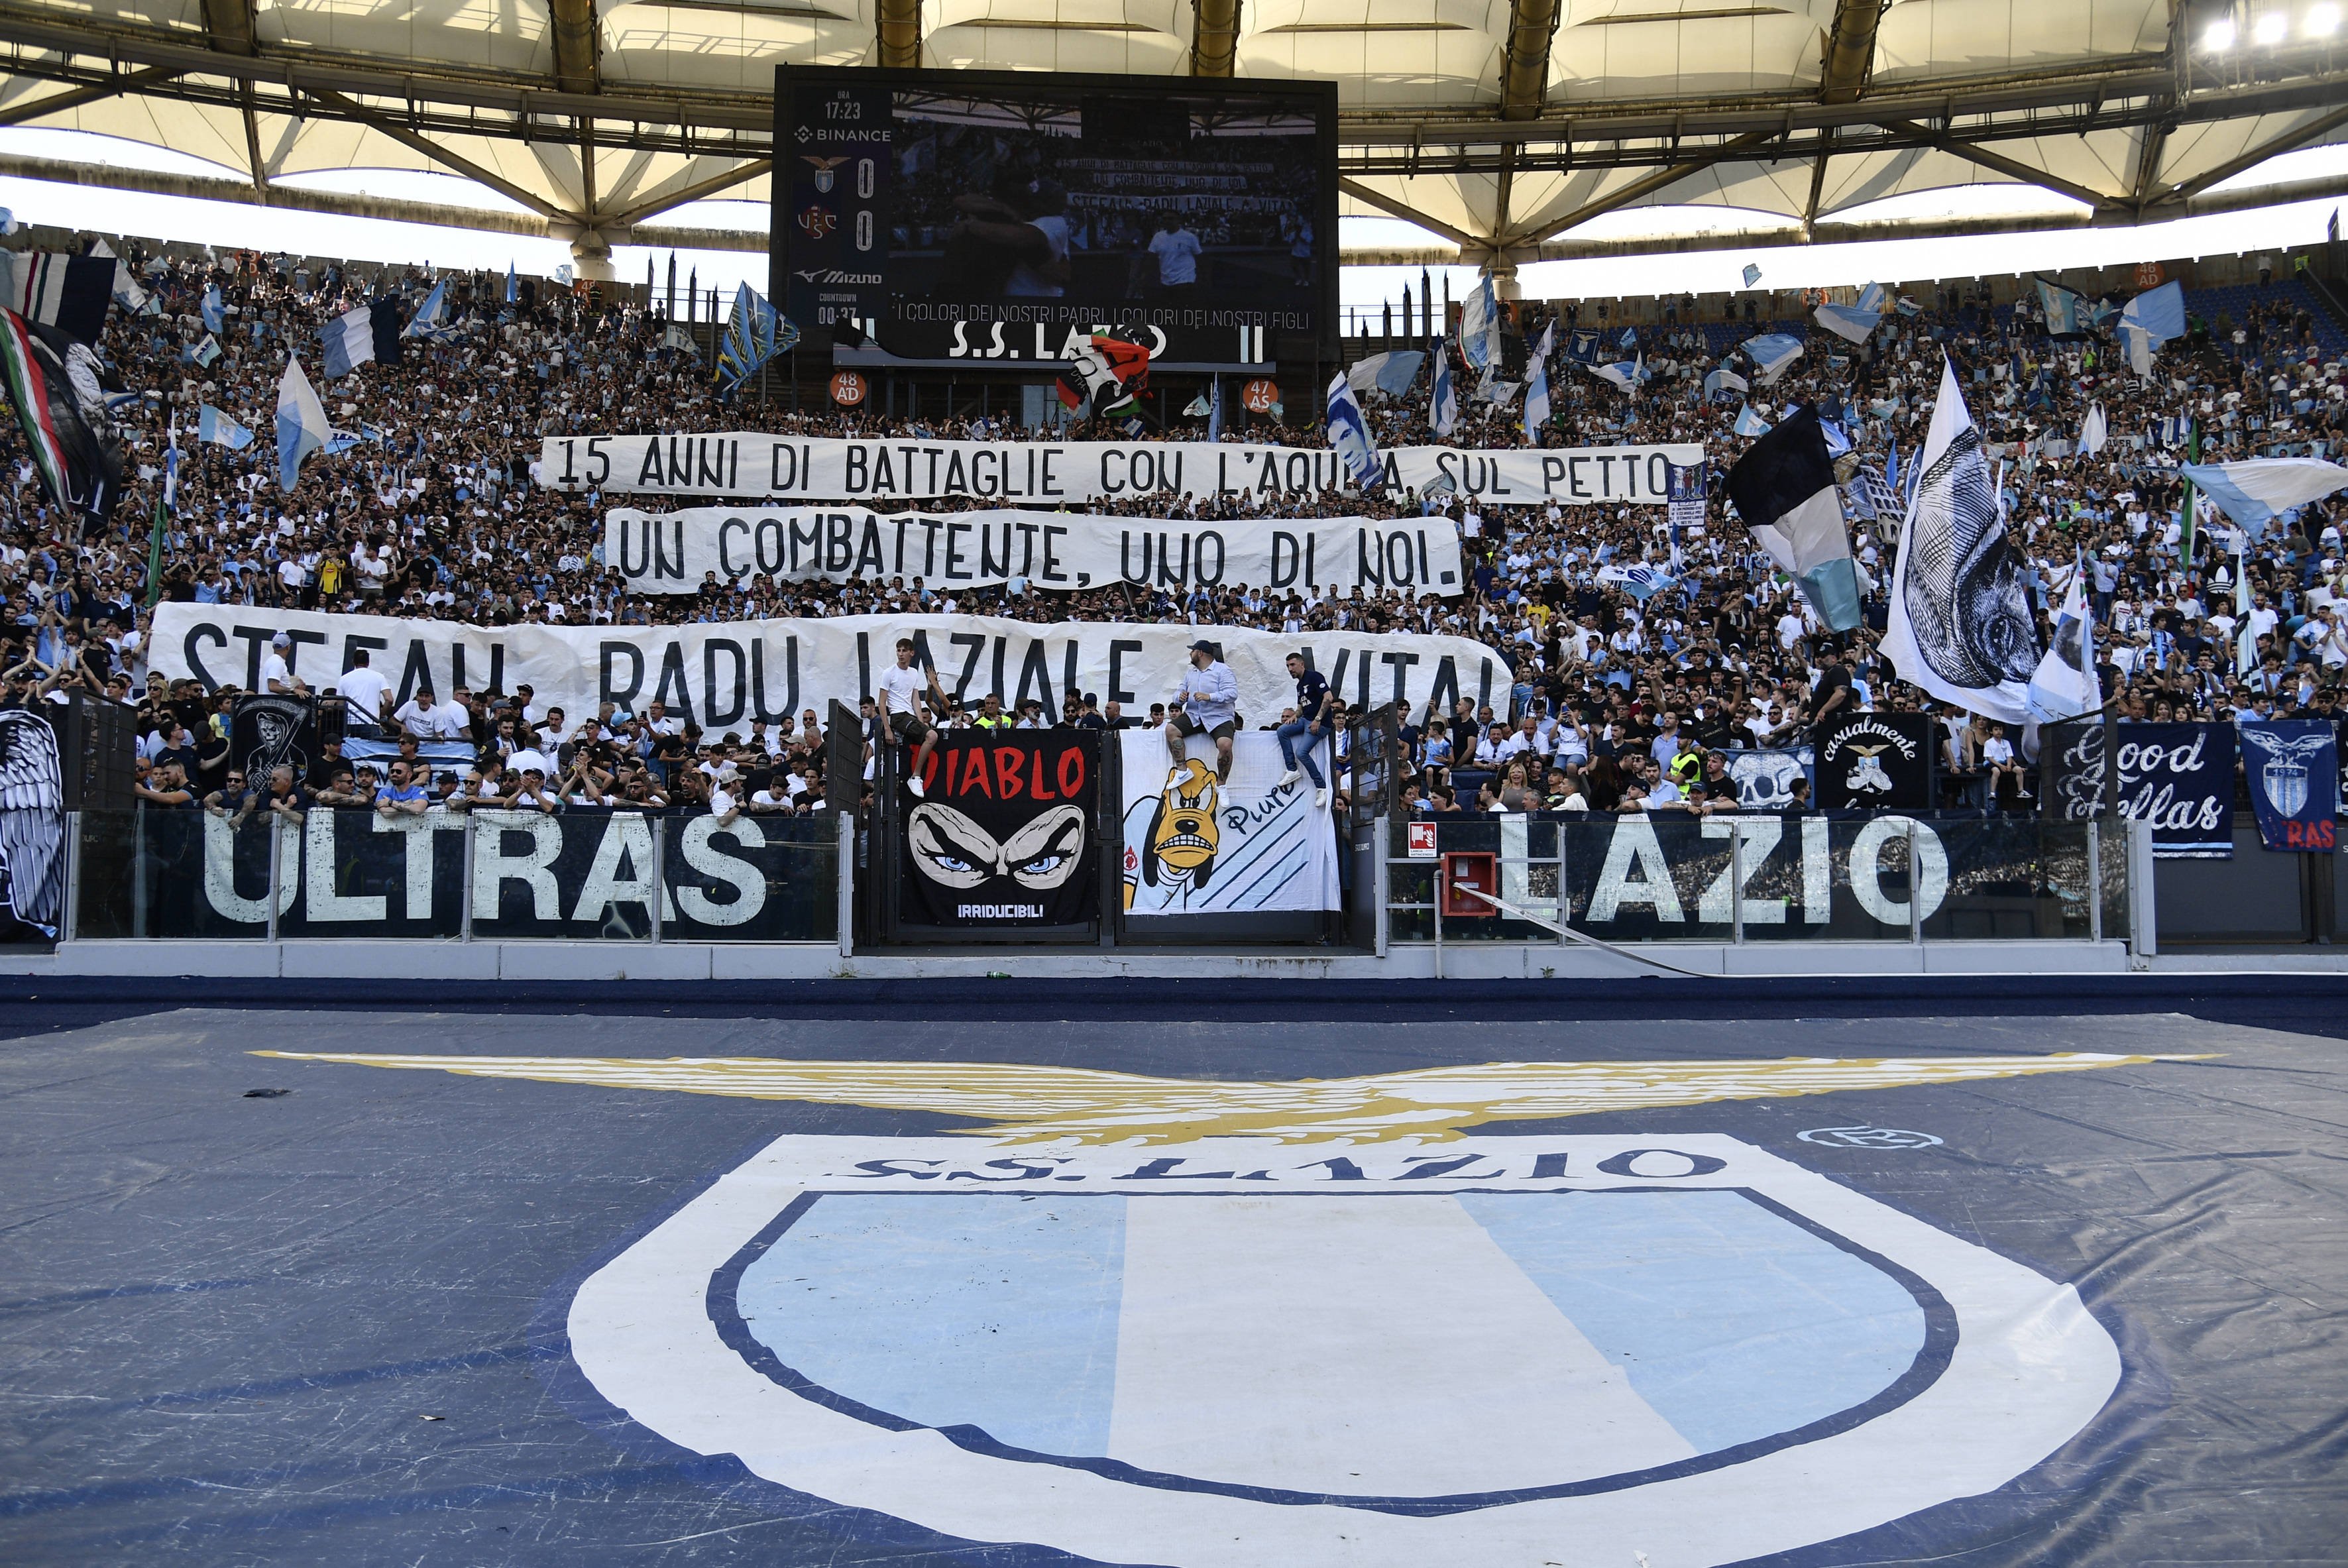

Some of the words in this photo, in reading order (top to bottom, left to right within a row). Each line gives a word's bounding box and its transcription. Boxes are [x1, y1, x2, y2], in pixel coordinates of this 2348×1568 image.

[838, 91, 850, 99] ORA
[826, 102, 861, 119] 17:23
[817, 129, 891, 142] BINANCE
[858, 158, 874, 199] 0
[856, 210, 873, 251] 0
[2139, 274, 2158, 285] AD
[2140, 264, 2156, 273] 46
[819, 293, 856, 302] COUNTDOWN
[898, 304, 901, 320] I
[907, 304, 964, 321] COLORI
[970, 305, 993, 321] DEI
[999, 306, 1053, 322] NOSTRI
[1060, 307, 1108, 323] PADRI.
[1122, 308, 1178, 325] COLORI
[1184, 309, 1207, 325] DEI
[1213, 310, 1266, 327] NOSTRI
[1273, 311, 1309, 329] FIGLI
[950, 321, 1019, 359] S.S.
[1036, 322, 1166, 360] LAO
[838, 372, 857, 386] 48
[1251, 381, 1269, 394] 47
[836, 387, 859, 401] AD
[1250, 396, 1270, 409] AS
[559, 437, 612, 483] 15
[638, 437, 738, 488] ANNI
[771, 443, 810, 491] DI
[845, 445, 1064, 496] BATTAGLIE
[1101, 449, 1182, 495] CON
[1219, 451, 1404, 495] L'AQUIA
[1435, 452, 1510, 494] SUL
[1542, 453, 1669, 497] PETTO
[620, 520, 685, 579] UN
[719, 514, 1090, 588] COMBATTENTE,
[1121, 530, 1225, 588] UNO
[1271, 531, 1315, 588] DI
[1358, 528, 1456, 587] NOI.
[600, 635, 800, 728] RADU
[1824, 715, 1917, 761] casualmente
[910, 744, 1085, 801] DIABLO
[204, 807, 767, 926] ULTRAS
[1500, 812, 1949, 926] LAZIO
[958, 903, 1044, 919] IRRIDUCIBILI
[822, 1157, 1087, 1182] S.S.
[1111, 1148, 1728, 1180] LAZIO
